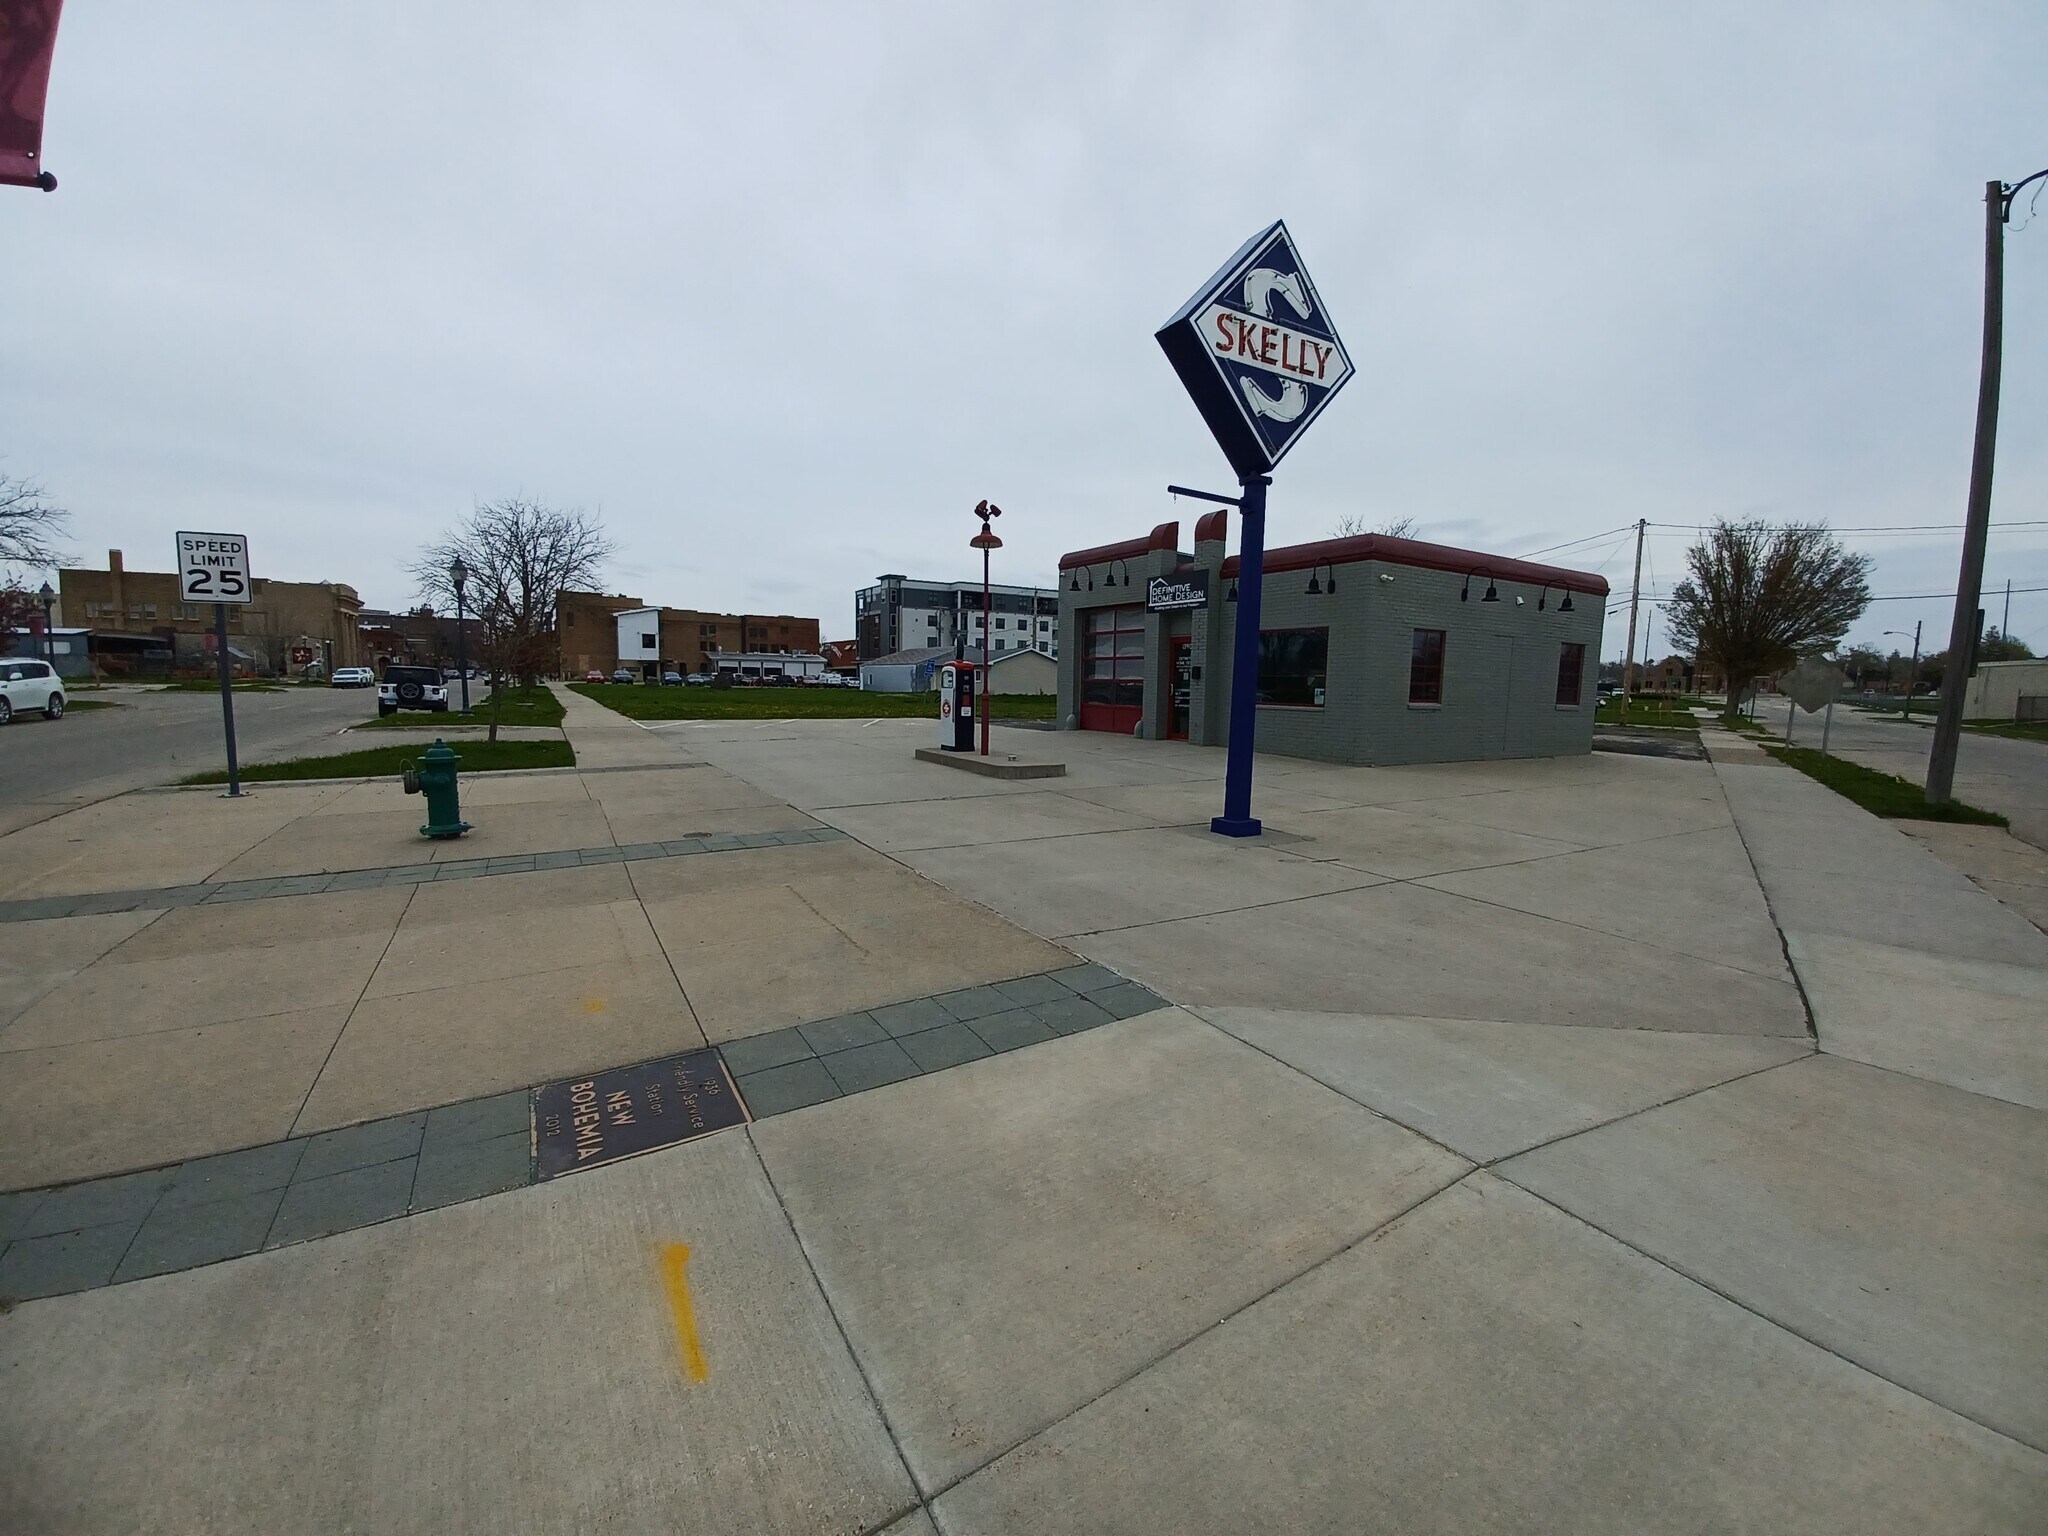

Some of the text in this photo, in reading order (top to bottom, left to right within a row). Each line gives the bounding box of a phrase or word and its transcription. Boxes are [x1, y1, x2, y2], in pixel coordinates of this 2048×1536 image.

[1215, 313, 1333, 380] SKELLY
[183, 540, 242, 553] SPEED
[191, 555, 236, 567] LIMIT
[186, 569, 244, 595] 25
[1152, 583, 1191, 596] DEFINITIVE
[1152, 590, 1204, 603] HOME DESIGN
[704, 1077, 722, 1095] 1936
[605, 1090, 636, 1125] NEW
[645, 1083, 664, 1116] Station
[683, 1093, 704, 1128] Service
[545, 1114, 560, 1136] 2012
[570, 1081, 604, 1160] BOHEMIA
